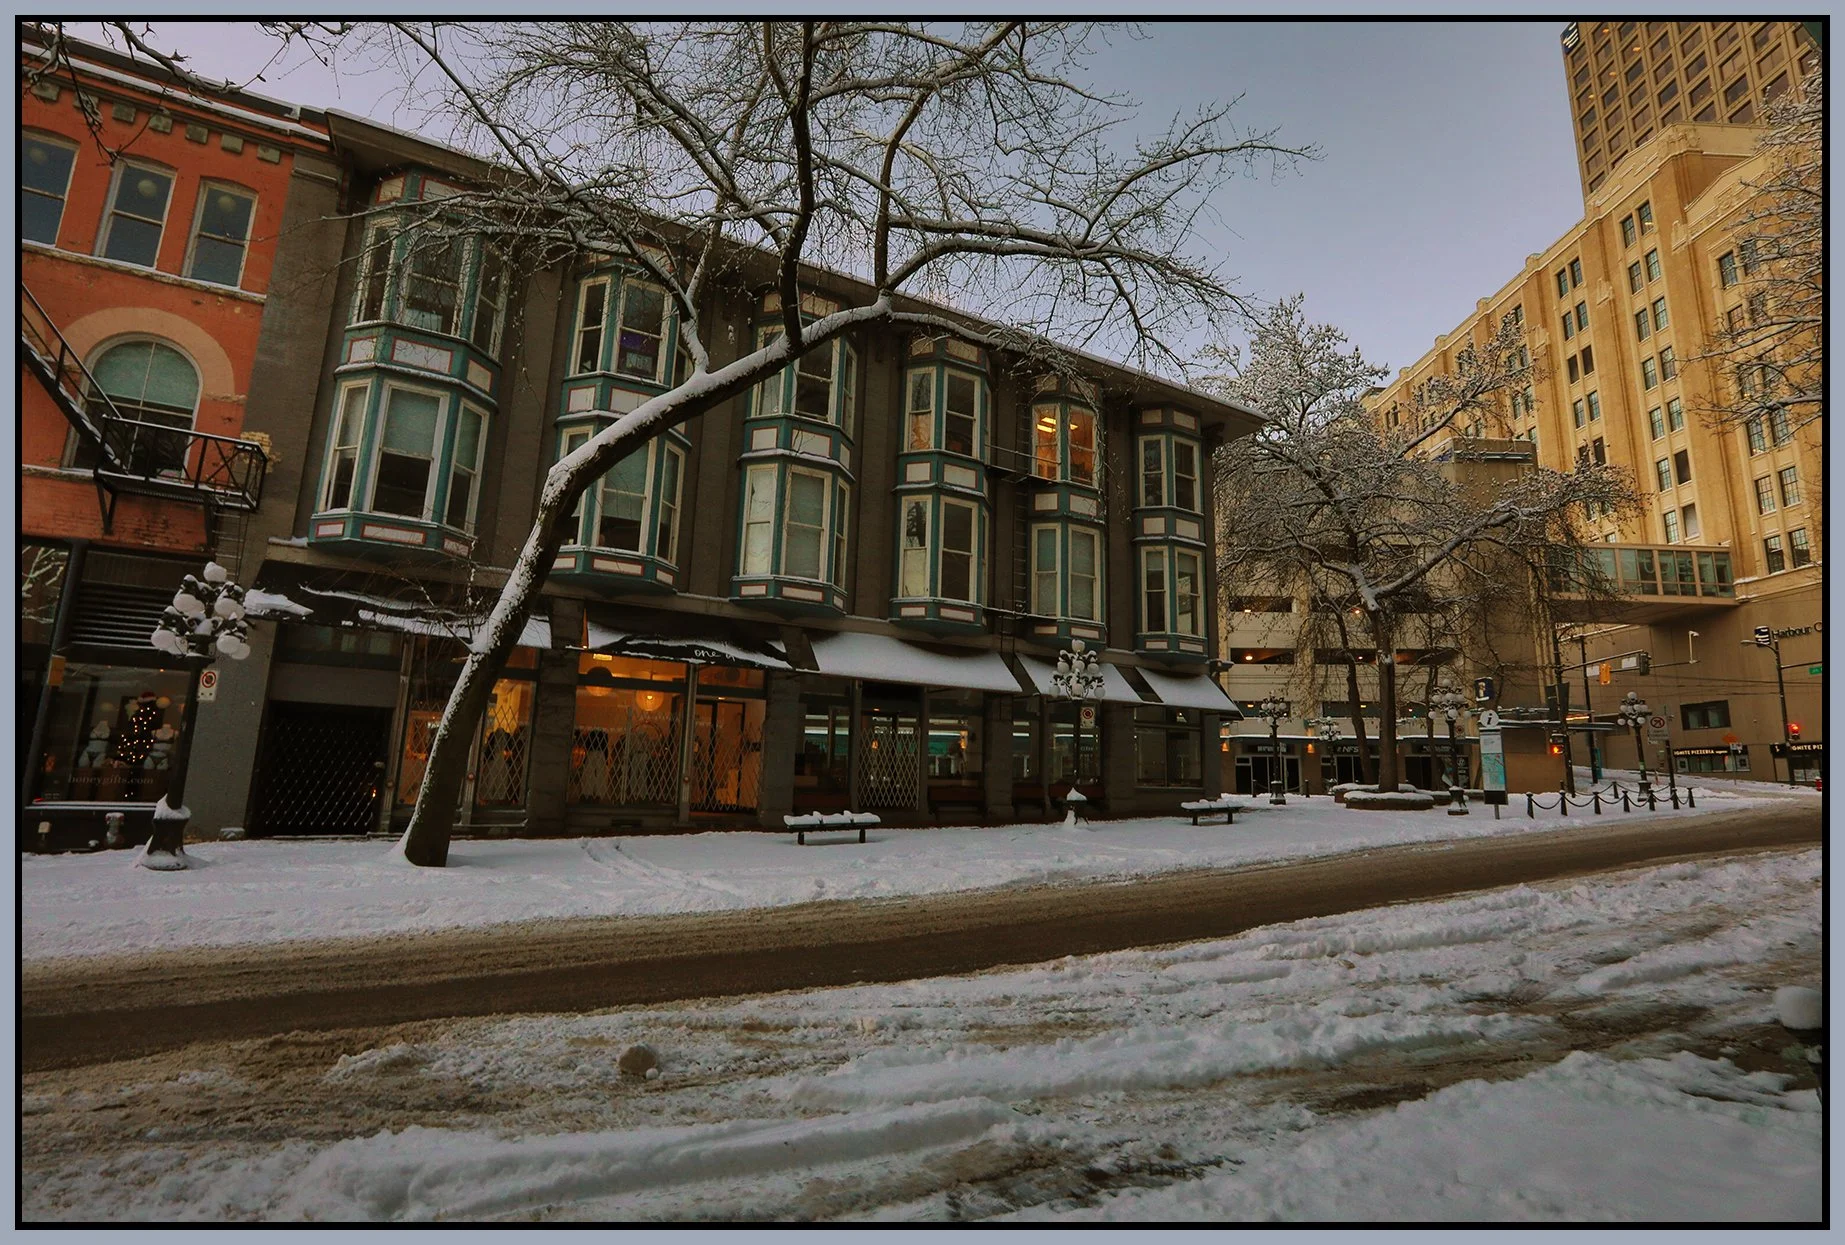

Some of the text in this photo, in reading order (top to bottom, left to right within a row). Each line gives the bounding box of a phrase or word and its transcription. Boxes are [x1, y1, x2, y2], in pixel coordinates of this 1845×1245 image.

[1772, 626, 1812, 639] Harbour
[694, 649, 721, 658] one
[67, 773, 154, 786] honeygifts.com
